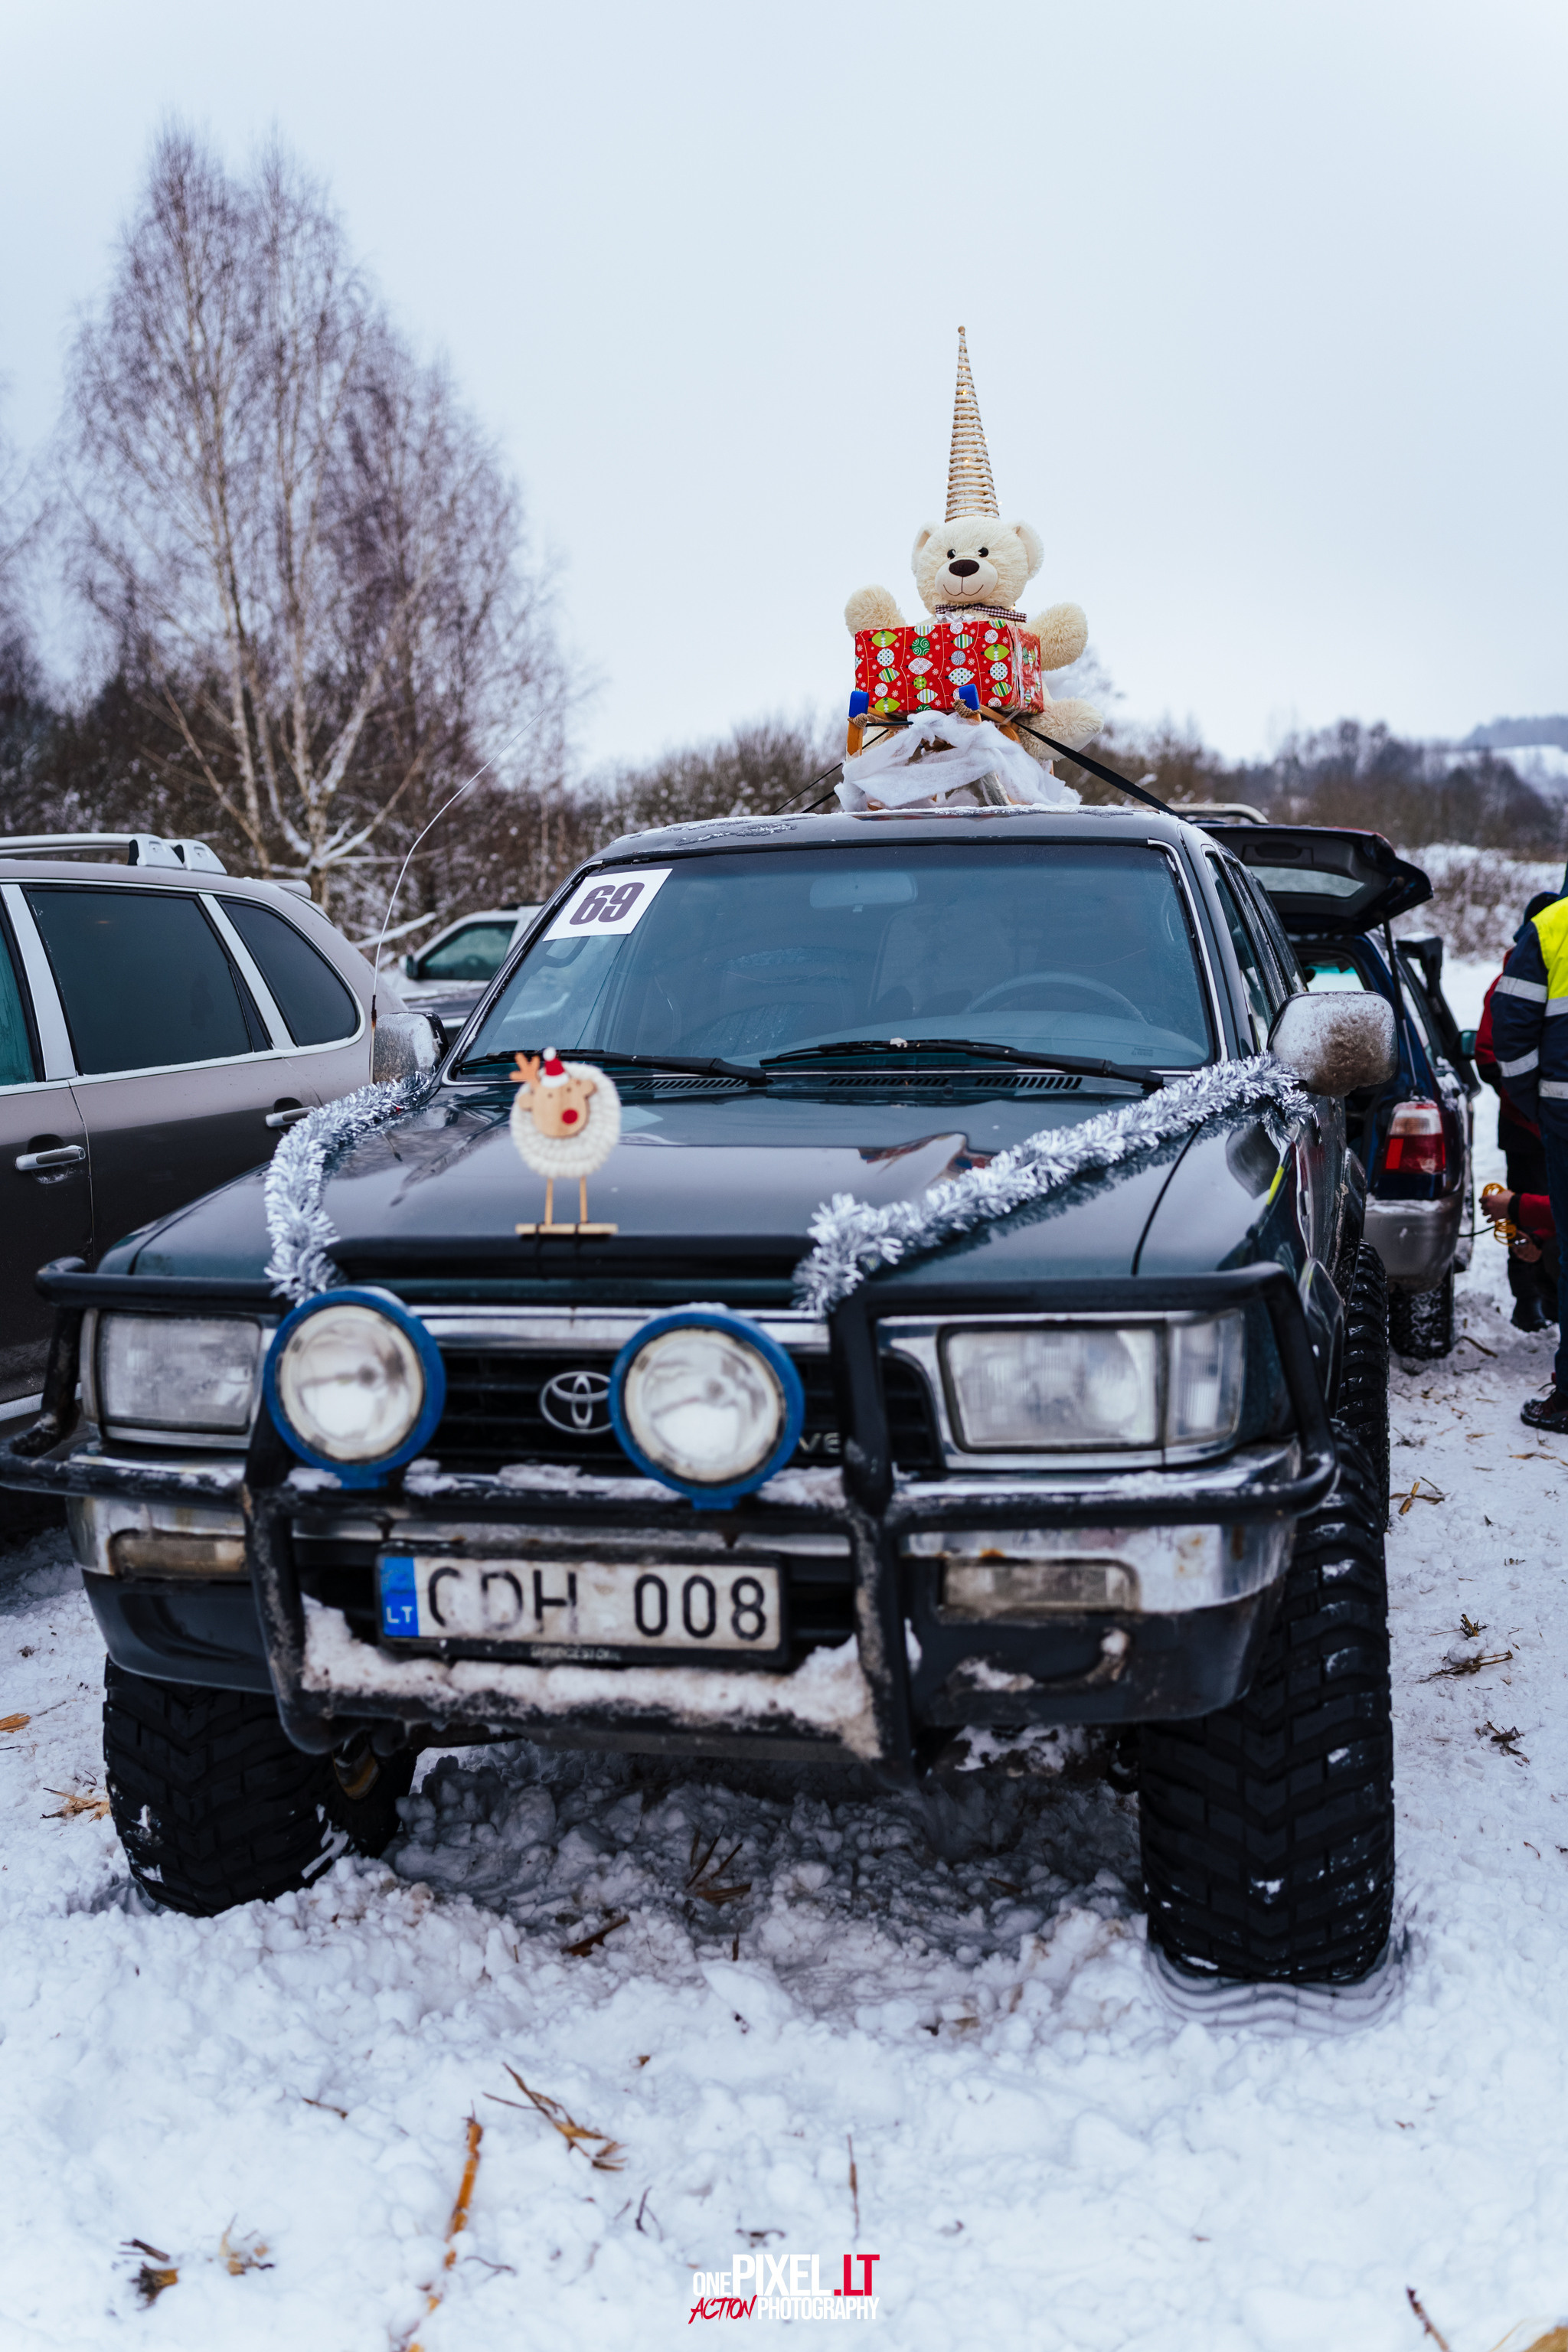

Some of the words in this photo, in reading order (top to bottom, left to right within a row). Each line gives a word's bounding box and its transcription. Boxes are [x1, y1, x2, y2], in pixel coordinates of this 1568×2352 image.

[570, 882, 645, 925] 69
[386, 1606, 413, 1623] LT
[634, 1574, 766, 1642] 008
